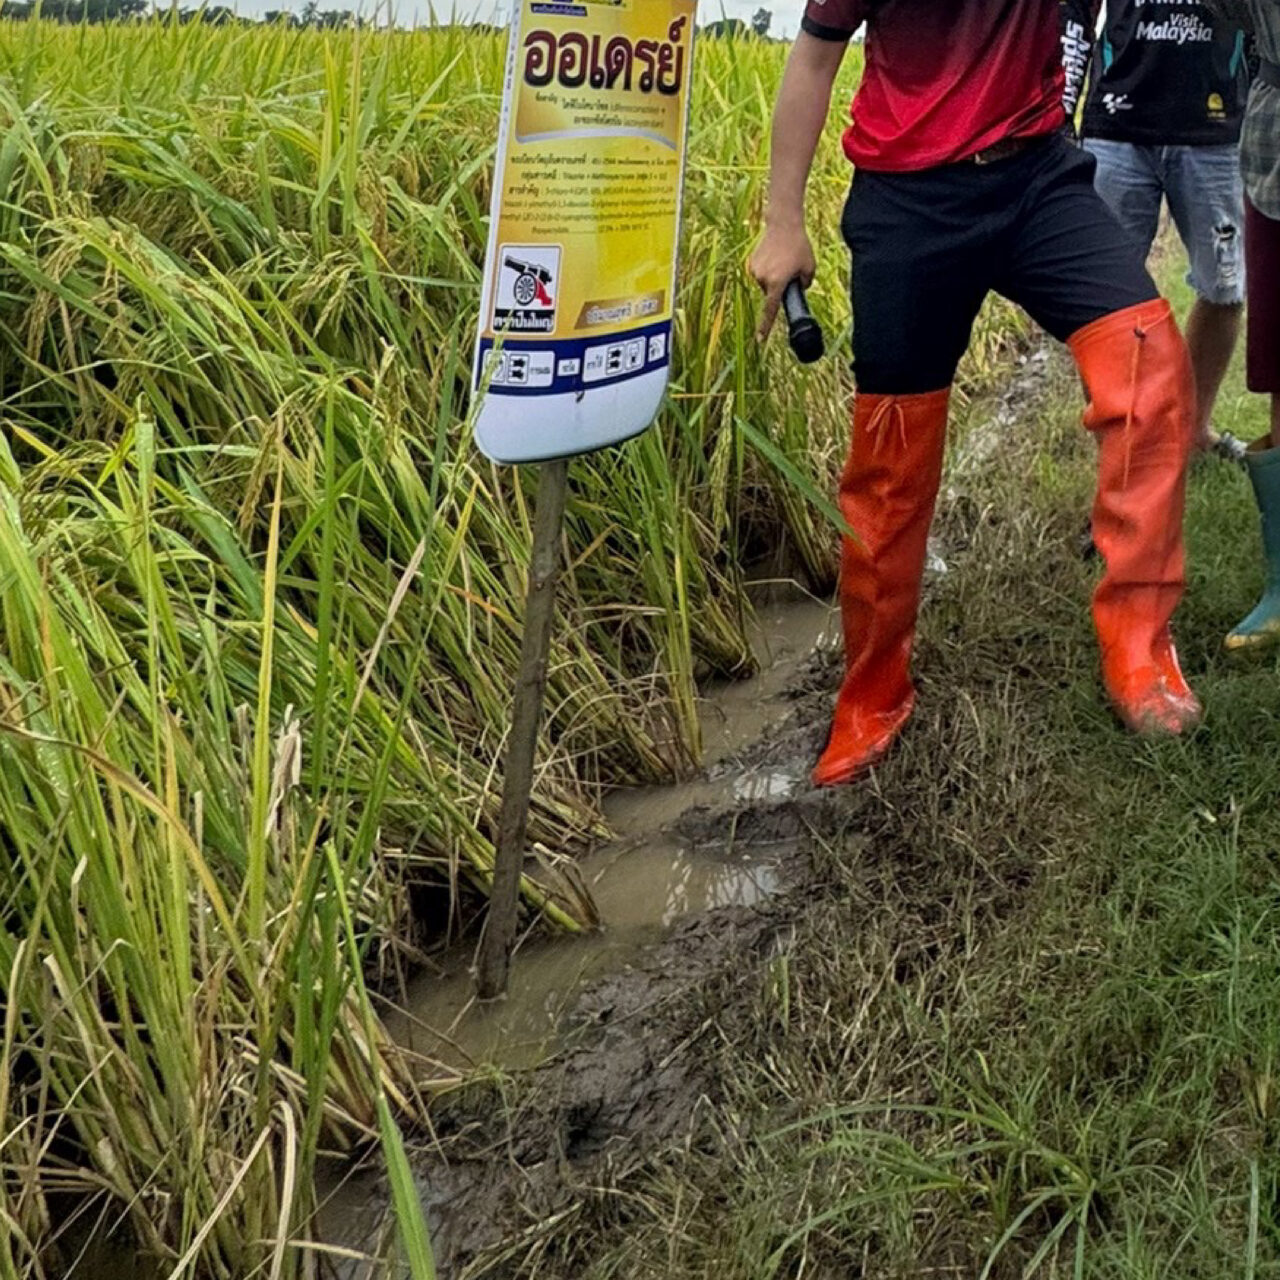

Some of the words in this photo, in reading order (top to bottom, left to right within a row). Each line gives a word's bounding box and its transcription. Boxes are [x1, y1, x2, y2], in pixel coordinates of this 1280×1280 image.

[1135, 20, 1213, 45] Malaysia
[1170, 12, 1200, 28] Visit
[523, 16, 687, 97] ออเดรย์
